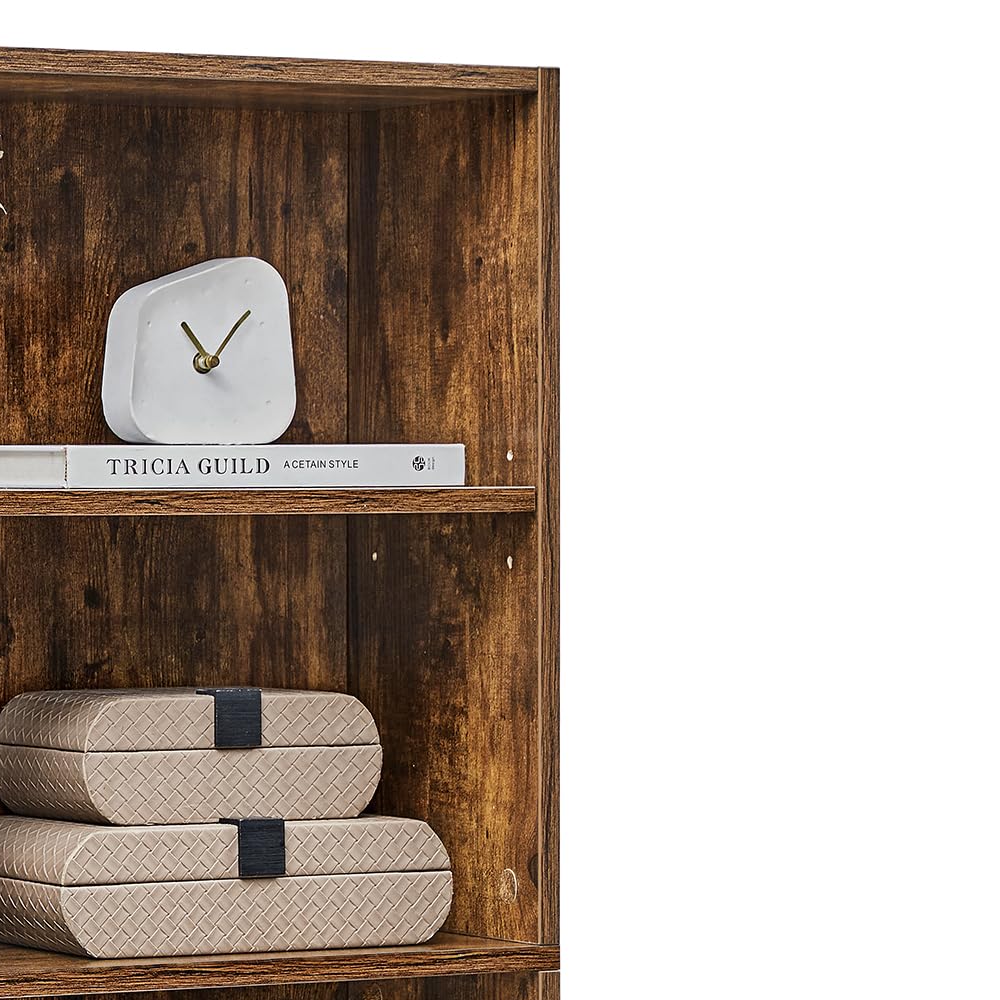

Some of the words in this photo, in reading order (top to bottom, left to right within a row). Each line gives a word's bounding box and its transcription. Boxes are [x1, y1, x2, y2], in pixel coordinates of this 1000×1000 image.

[106, 458, 191, 475] TRICIA
[198, 458, 271, 475] GUILD
[283, 460, 290, 469] A
[291, 460, 327, 469] CETAIN
[329, 460, 359, 469] STYLE
